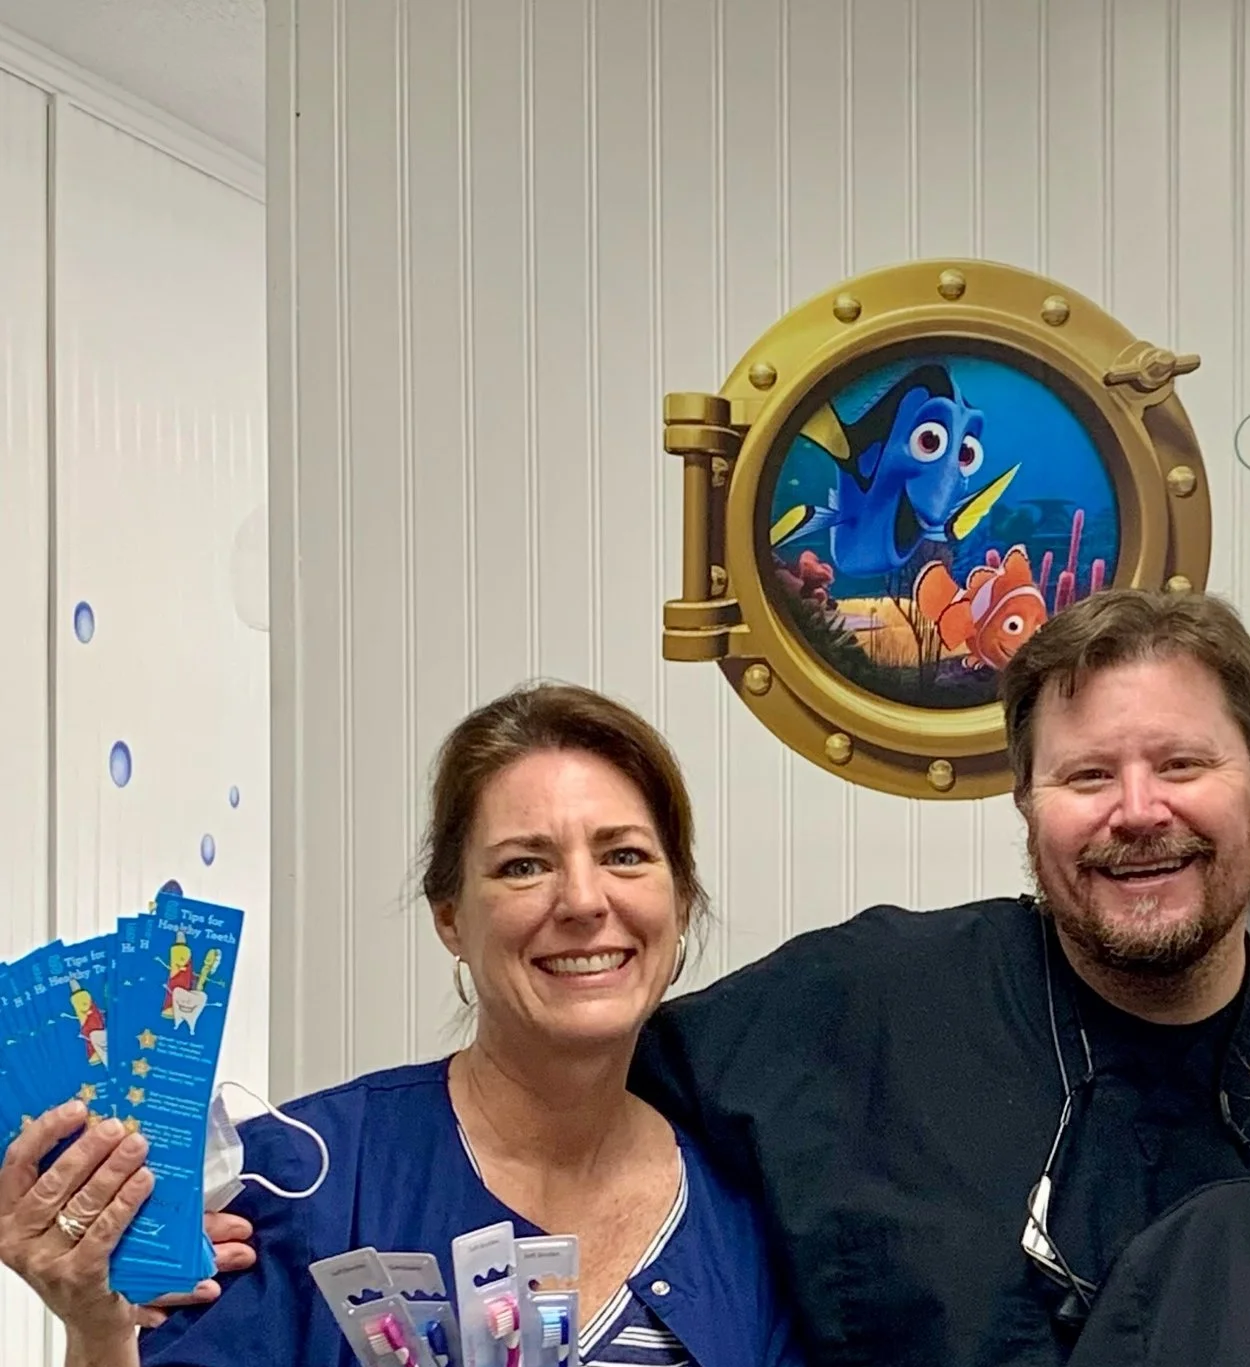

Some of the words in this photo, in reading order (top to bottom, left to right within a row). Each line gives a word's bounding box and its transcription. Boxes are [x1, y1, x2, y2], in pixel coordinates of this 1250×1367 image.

[181, 908, 205, 924] Tips
[207, 914, 225, 928] for
[158, 918, 202, 939] Healthy
[204, 928, 237, 945] Teeth
